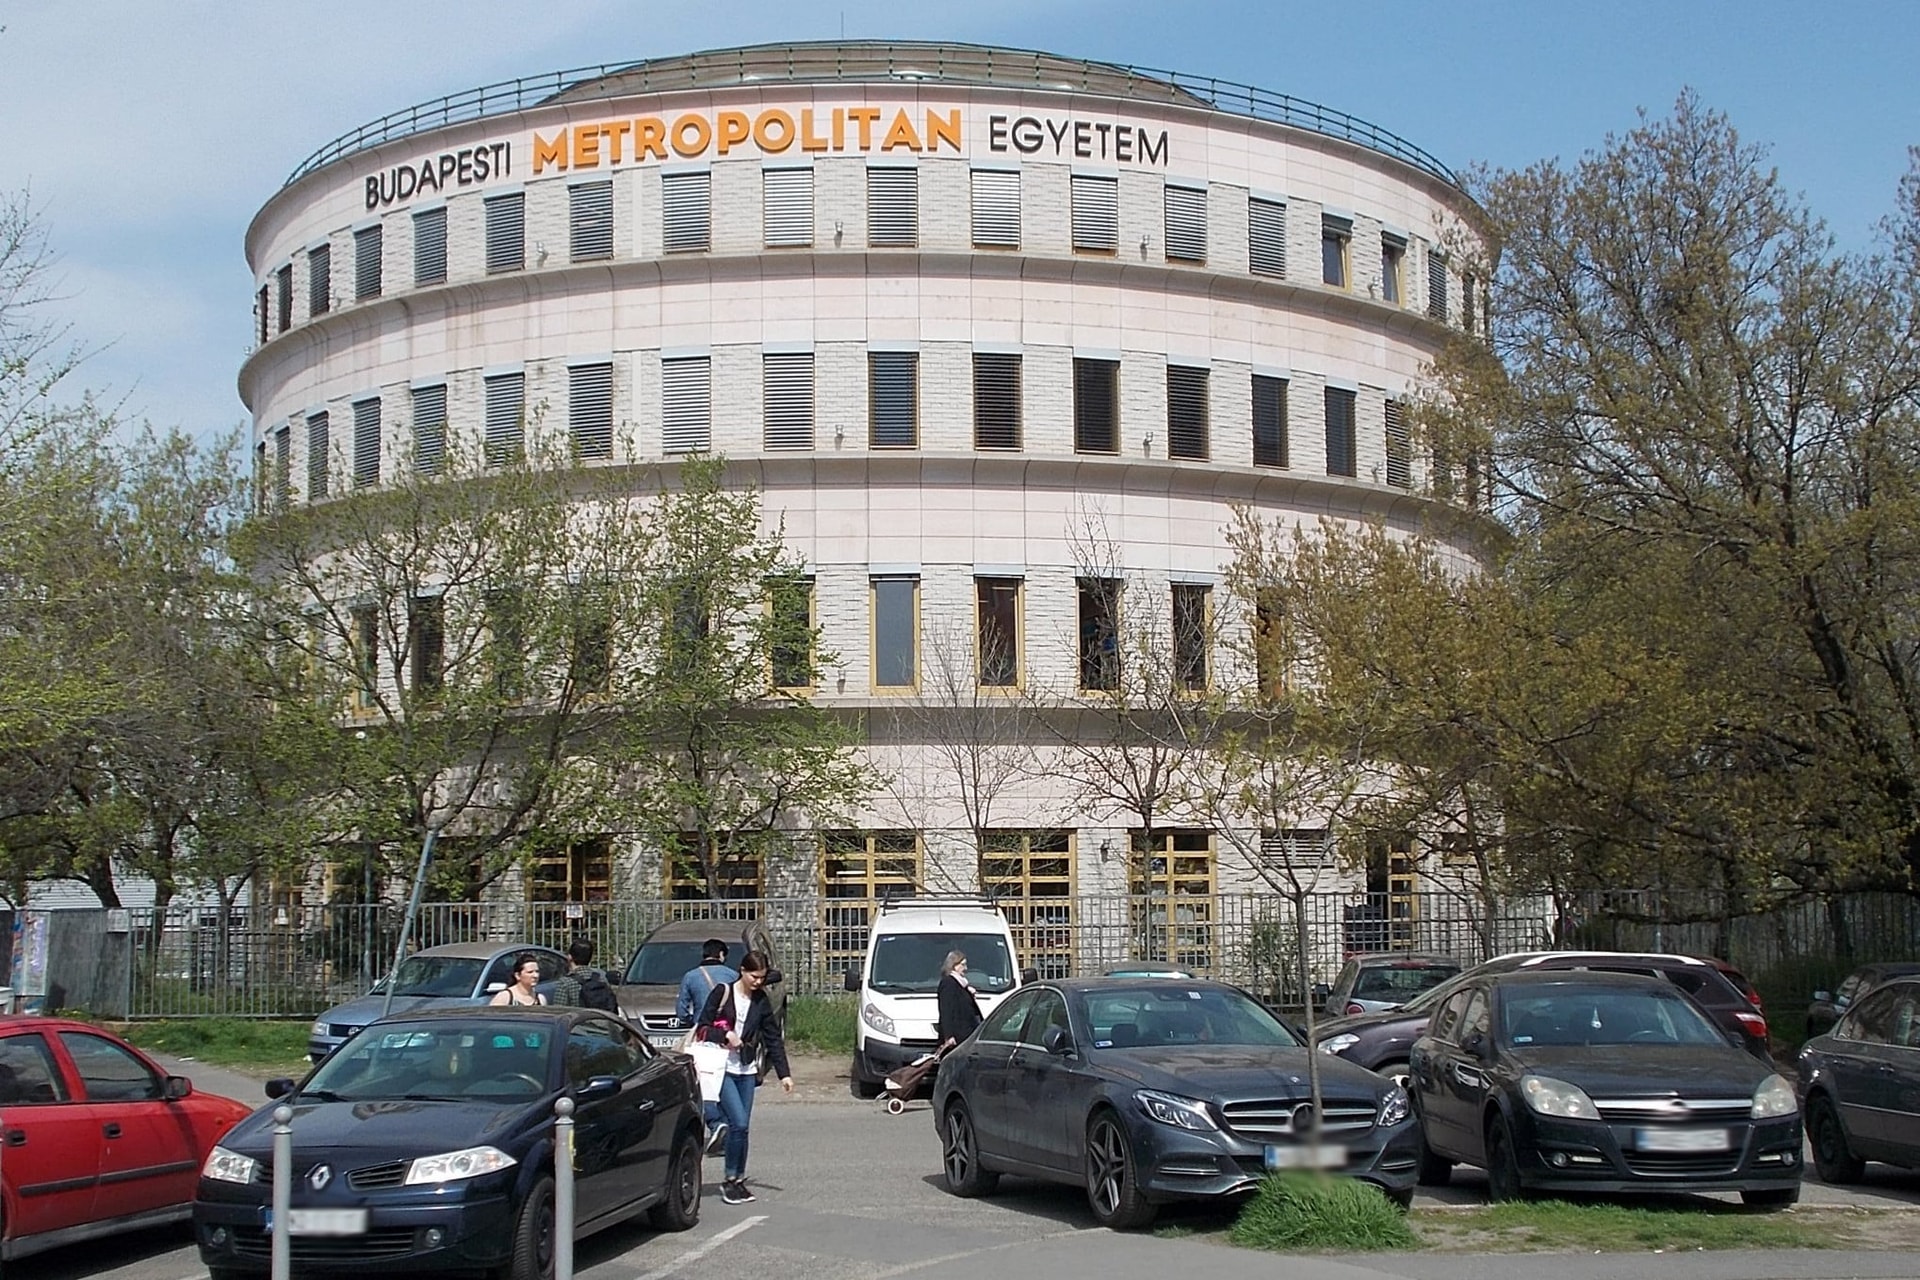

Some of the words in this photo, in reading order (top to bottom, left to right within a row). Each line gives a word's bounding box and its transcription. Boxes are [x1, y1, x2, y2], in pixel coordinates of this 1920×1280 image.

[365, 141, 511, 210] BUDAPESTI
[533, 107, 962, 173] METROPOLITAN
[989, 115, 1169, 165] EGYETEM
